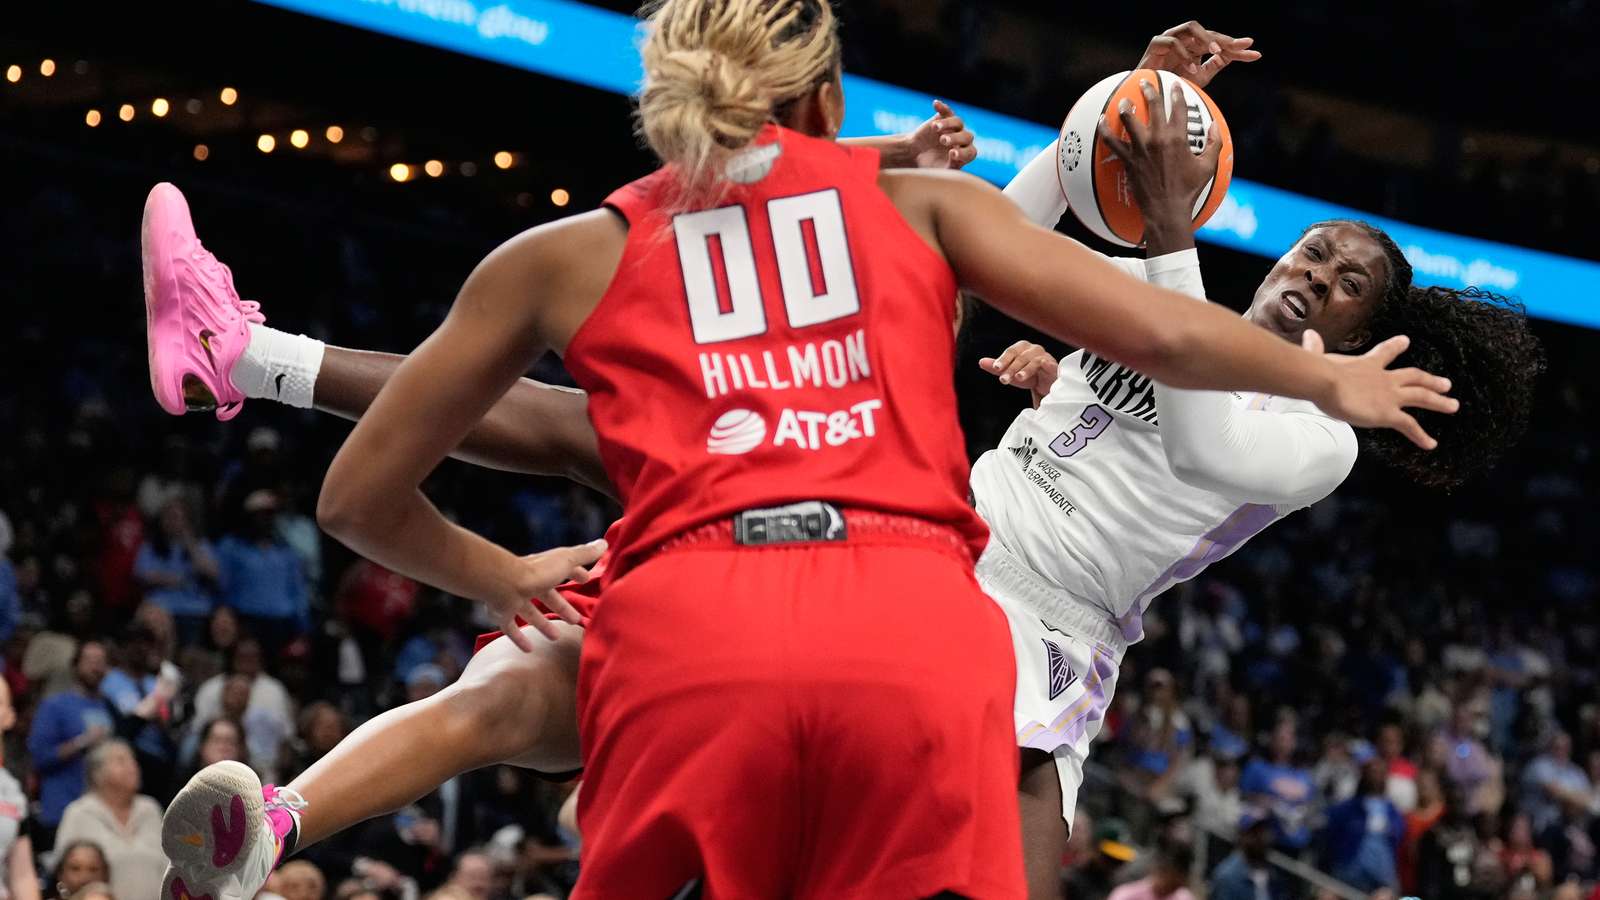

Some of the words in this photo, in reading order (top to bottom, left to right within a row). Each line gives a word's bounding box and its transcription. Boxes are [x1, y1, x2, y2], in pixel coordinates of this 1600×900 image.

[672, 187, 861, 345] 00
[699, 329, 871, 399] HILLMON
[773, 399, 882, 450] AT&T
[1048, 403, 1114, 458] 3
[1026, 468, 1077, 518] PERMANENTE
[1036, 458, 1062, 483] KAISER
